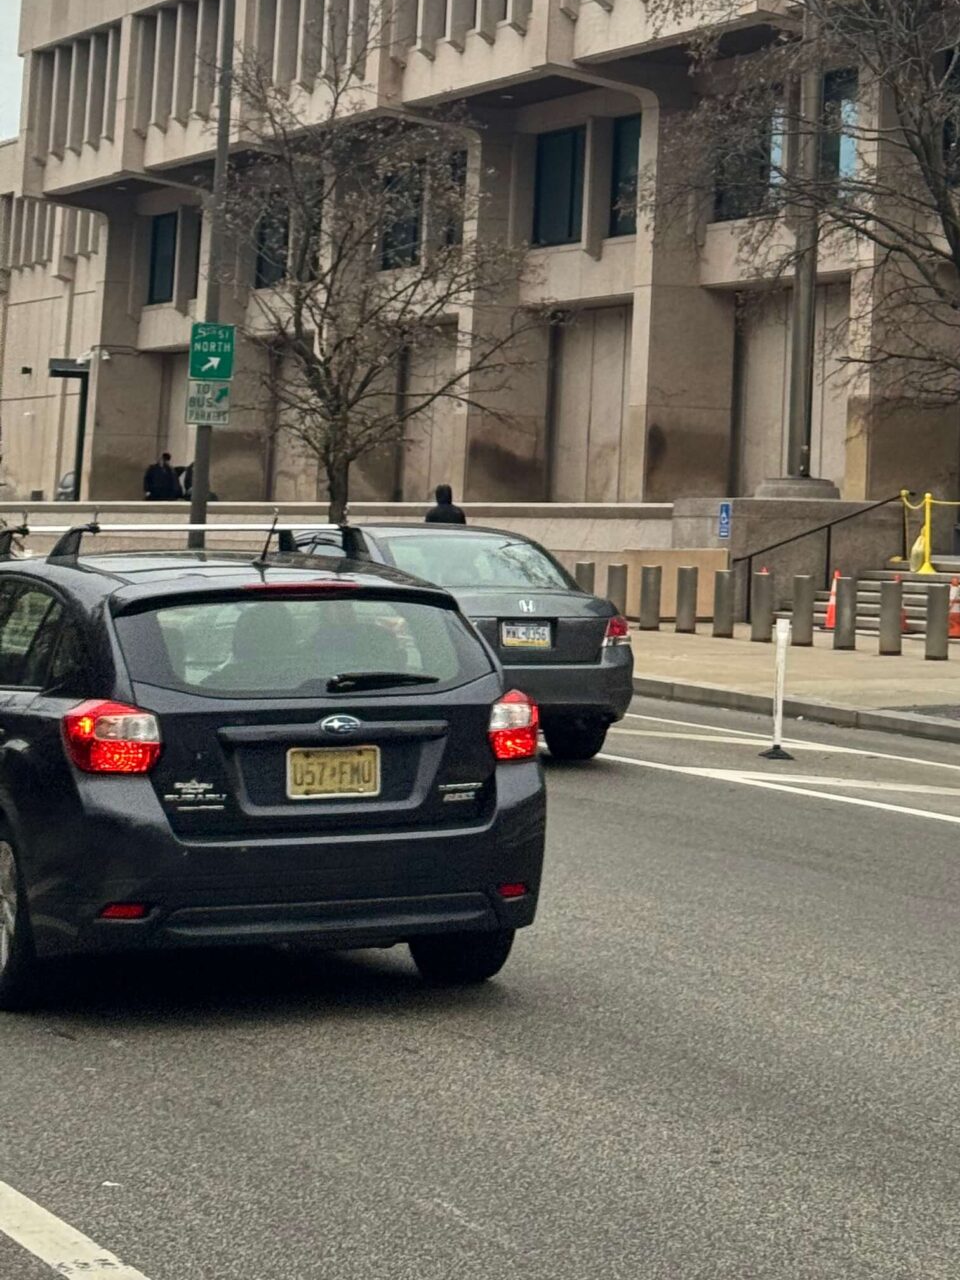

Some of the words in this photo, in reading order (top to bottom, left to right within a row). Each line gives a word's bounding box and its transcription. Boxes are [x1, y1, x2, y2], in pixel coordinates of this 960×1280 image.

[194, 341, 231, 352] NORTH
[196, 384, 211, 395] TO
[189, 397, 213, 408] BUS
